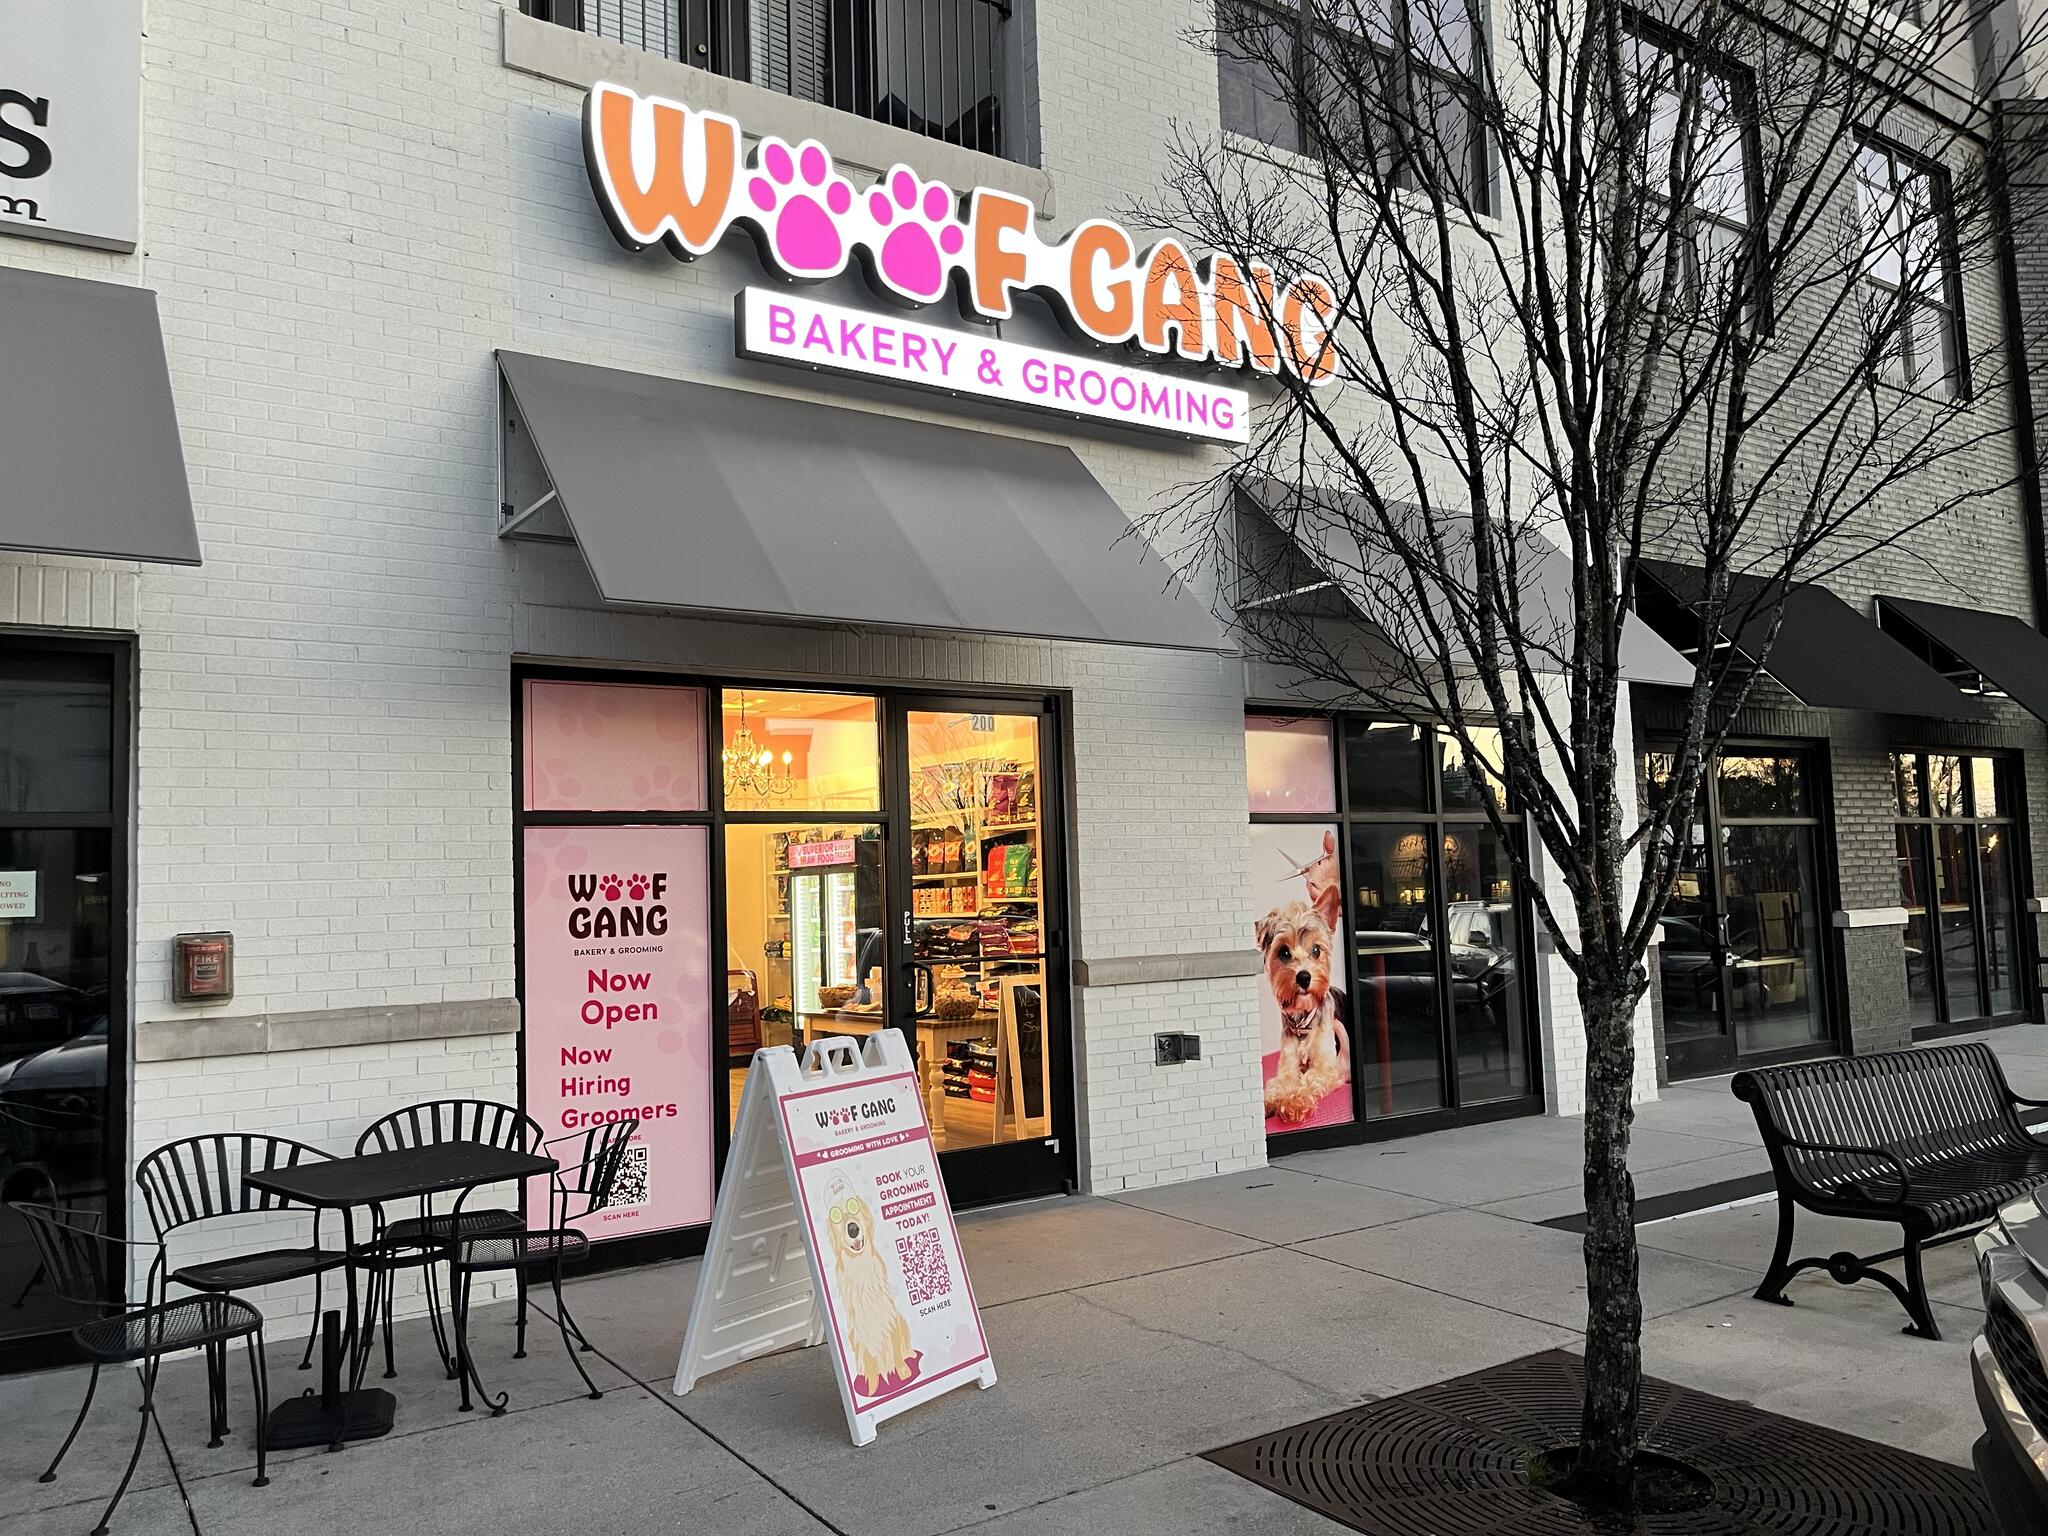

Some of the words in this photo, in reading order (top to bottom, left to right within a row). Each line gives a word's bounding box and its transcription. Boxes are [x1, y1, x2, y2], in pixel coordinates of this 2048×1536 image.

[1069, 224, 1338, 382] GANG
[768, 304, 958, 377] BAKERY
[976, 348, 1004, 388] &
[1022, 357, 1235, 431] GROOMING
[972, 715, 995, 732] 200
[802, 843, 834, 856] SUPERIOR
[817, 853, 834, 864] FOOD
[568, 904, 668, 940] GANG
[194, 953, 220, 963] FIRE
[573, 947, 608, 957] BAKERY
[609, 947, 616, 955] &
[618, 945, 664, 955] GROOMING
[587, 968, 652, 994] Now
[580, 999, 658, 1030] Open
[560, 1046, 612, 1067] Now
[560, 1075, 632, 1098] Hiring
[560, 1102, 679, 1129] Groomers
[861, 1097, 896, 1119] GANG
[834, 1126, 855, 1137] BAKERY
[859, 1120, 886, 1131] GROOMING
[830, 1143, 865, 1158] GROOMING
[865, 1139, 882, 1149] WITH
[881, 1135, 898, 1145] LOVE
[875, 1170, 902, 1186] BOOK
[902, 1164, 926, 1179] YOUR
[880, 1178, 930, 1201] GROOMING
[602, 1213, 622, 1222] SCAN
[622, 1210, 640, 1220] HERE
[884, 1195, 934, 1217] APPOINTMENT
[895, 1212, 931, 1231] TODAY!
[919, 1305, 937, 1317] SCAN
[936, 1299, 952, 1310] HERE
